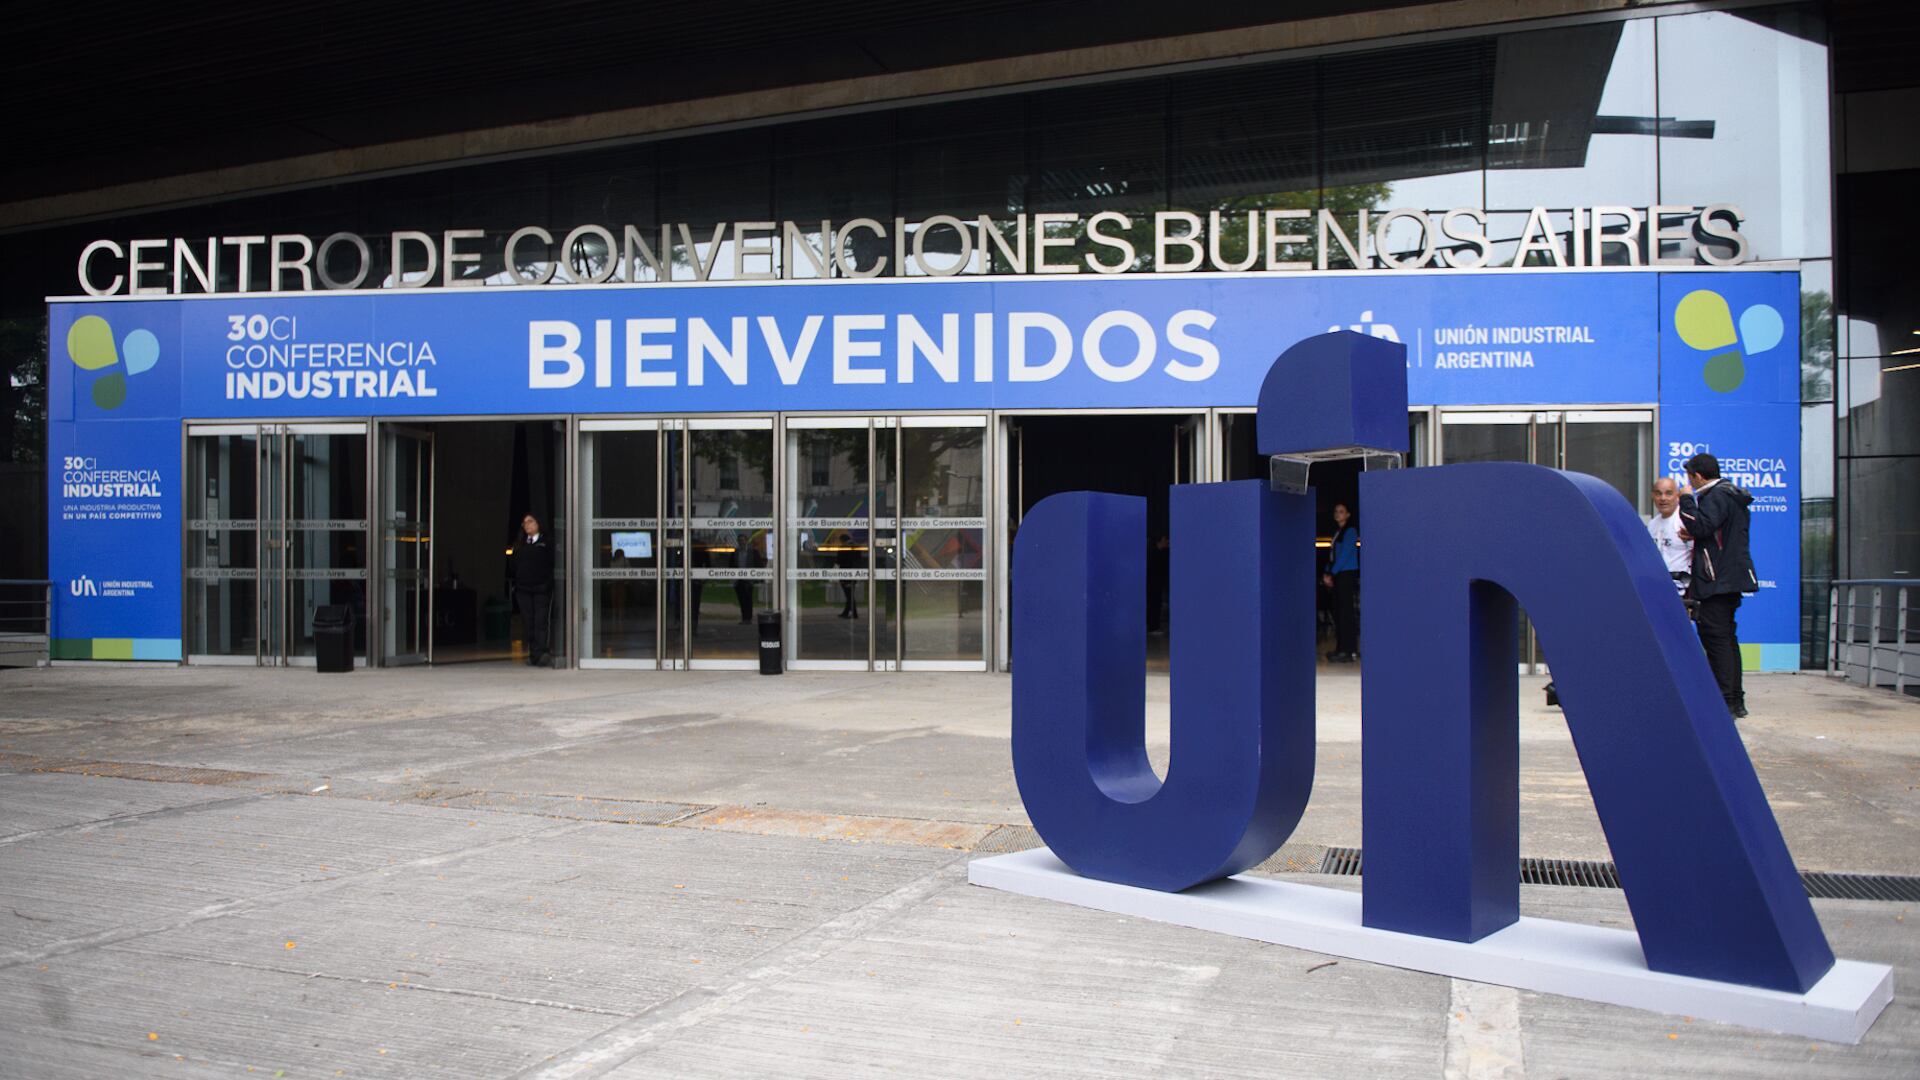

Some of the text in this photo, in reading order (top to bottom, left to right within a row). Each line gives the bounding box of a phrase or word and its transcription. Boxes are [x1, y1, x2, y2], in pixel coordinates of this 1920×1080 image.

[78, 203, 1749, 297] CENTRO DE CONVENCIONES BUENOS AIRES
[227, 314, 297, 342] 30CI
[1434, 324, 1595, 345] UNIÓN INDUSTRIAL
[226, 341, 438, 369] CONFERENCIA
[528, 309, 1221, 389] BIENVENIDOS
[1434, 351, 1535, 369] ARGENTINA
[226, 370, 438, 400] INDUSTRIAL
[64, 457, 97, 470] 30CI
[1668, 458, 1787, 472] COERENCIA
[63, 470, 161, 483] CONFERENCIA
[63, 484, 161, 497] INDUSTRIAL
[628, 519, 638, 527] de
[707, 519, 735, 527] Centro
[736, 519, 747, 527] de
